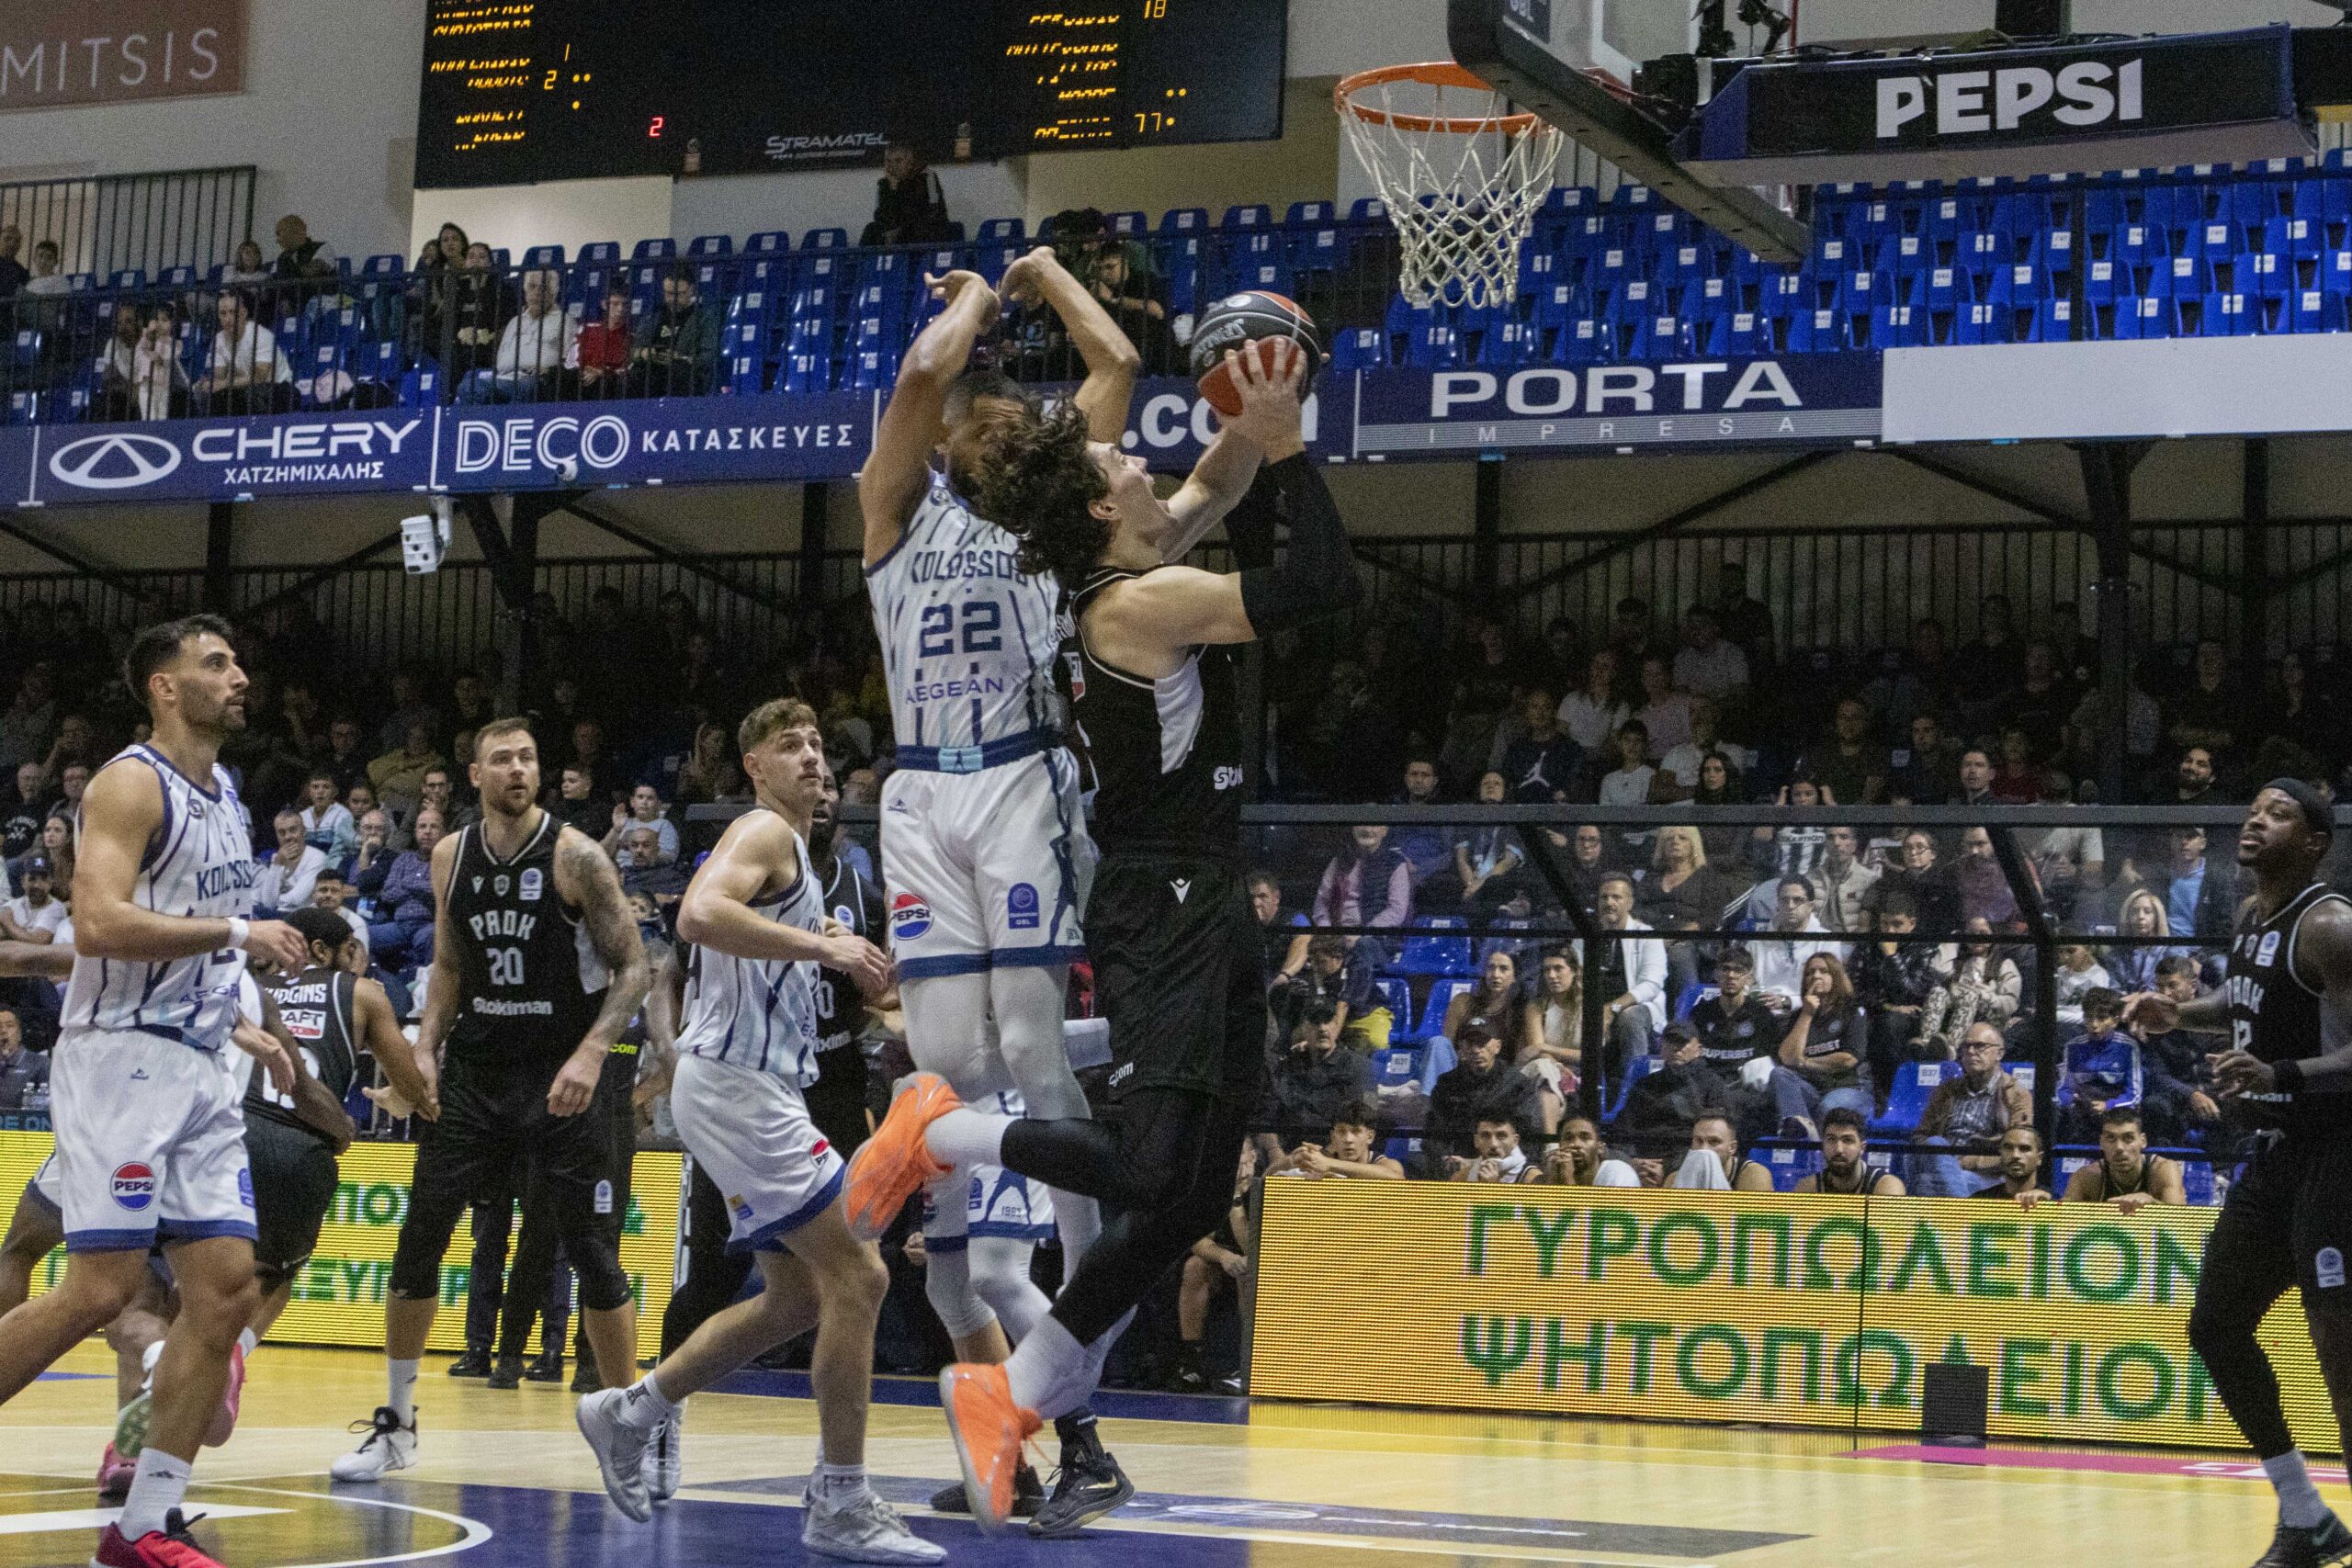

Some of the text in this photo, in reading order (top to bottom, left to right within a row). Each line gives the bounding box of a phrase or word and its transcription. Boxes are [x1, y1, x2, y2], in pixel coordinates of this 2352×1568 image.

[0, 28, 218, 92] MITSIS
[1875, 58, 2143, 139] PEPSI
[649, 118, 662, 137] 2
[766, 133, 888, 152] STRAMATEL
[1430, 361, 1803, 418] PORTA
[192, 420, 421, 461] CHERY
[455, 415, 630, 473] DECO
[642, 423, 854, 453] ΚΑΤΑΣΚΕΥΕΣ
[223, 461, 385, 485] ΧΑΤΖΗΜΙΧΑΛΗΣ
[920, 602, 1002, 658] 22
[906, 677, 1004, 705] AEGEAN
[469, 910, 536, 941] PAOK
[486, 946, 525, 985] 20
[114, 1181, 153, 1191] PEPSI
